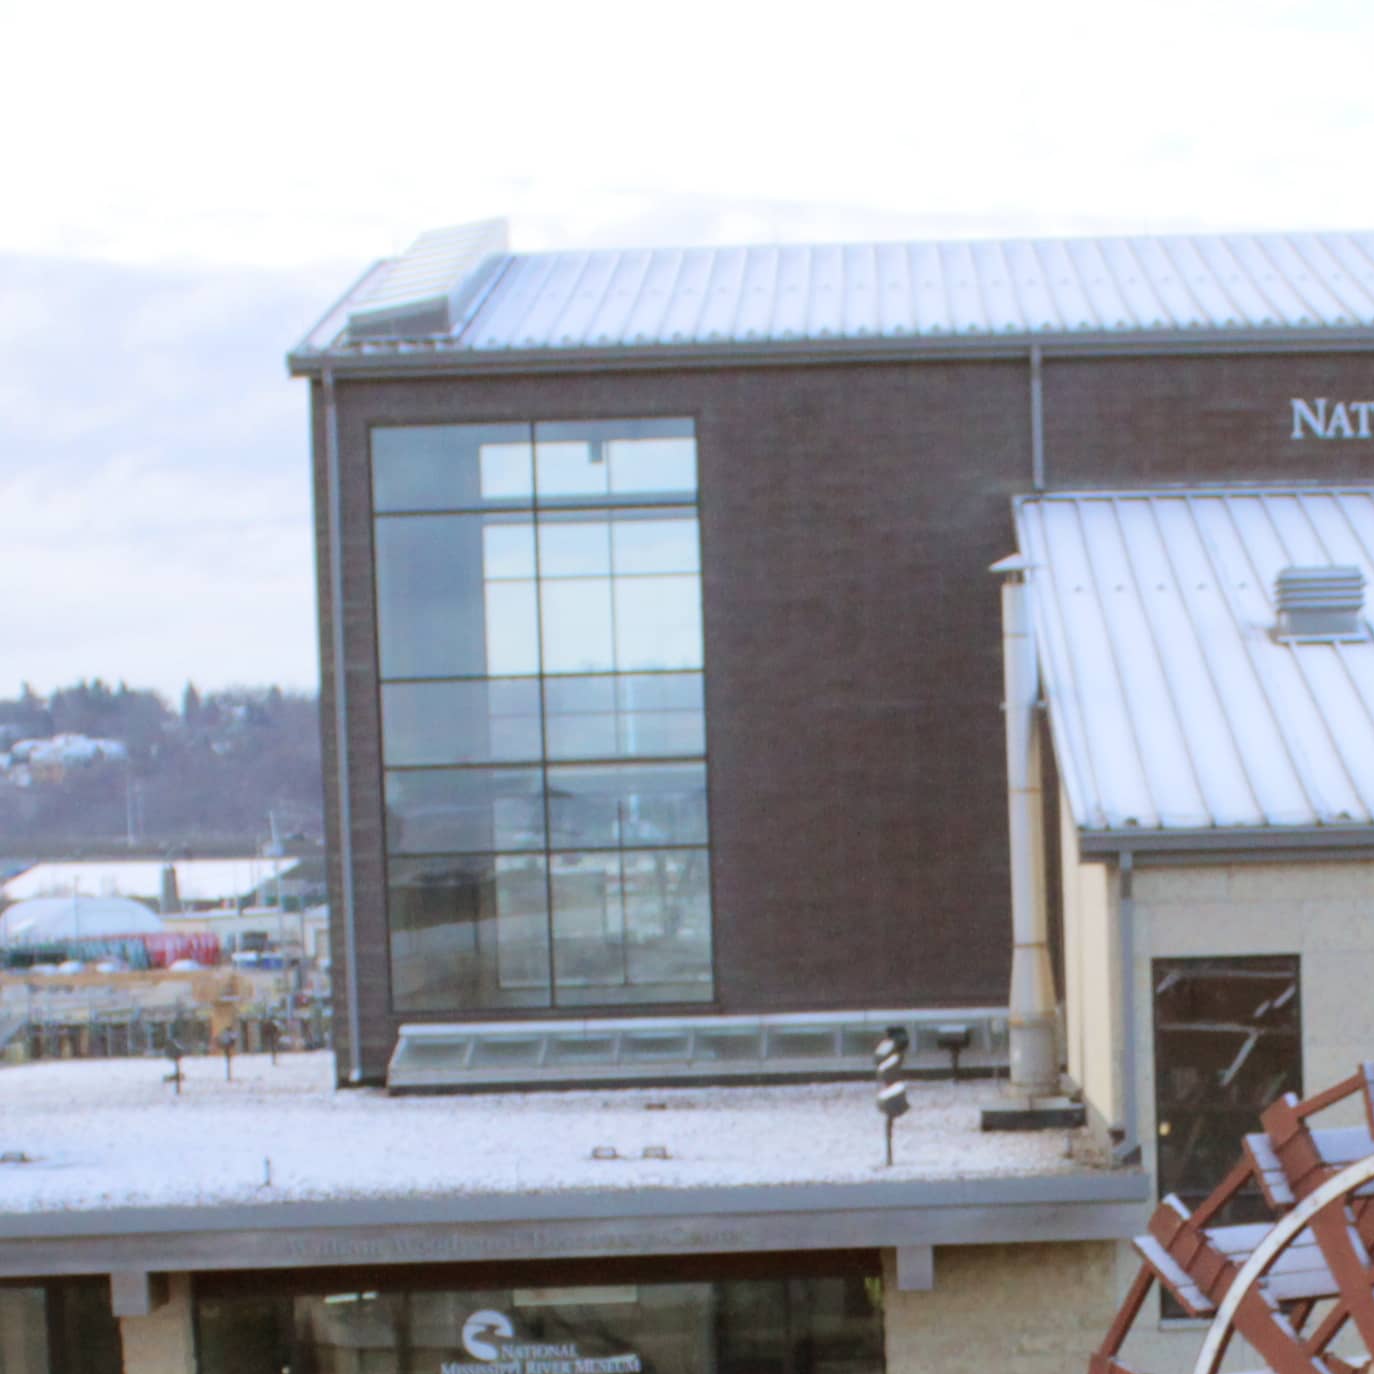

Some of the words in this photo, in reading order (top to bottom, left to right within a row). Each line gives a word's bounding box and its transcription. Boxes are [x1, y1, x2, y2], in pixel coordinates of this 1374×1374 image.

[501, 1344, 577, 1359] NATIONAL
[525, 1360, 569, 1374] RIVER
[575, 1357, 641, 1374] MUSEUM
